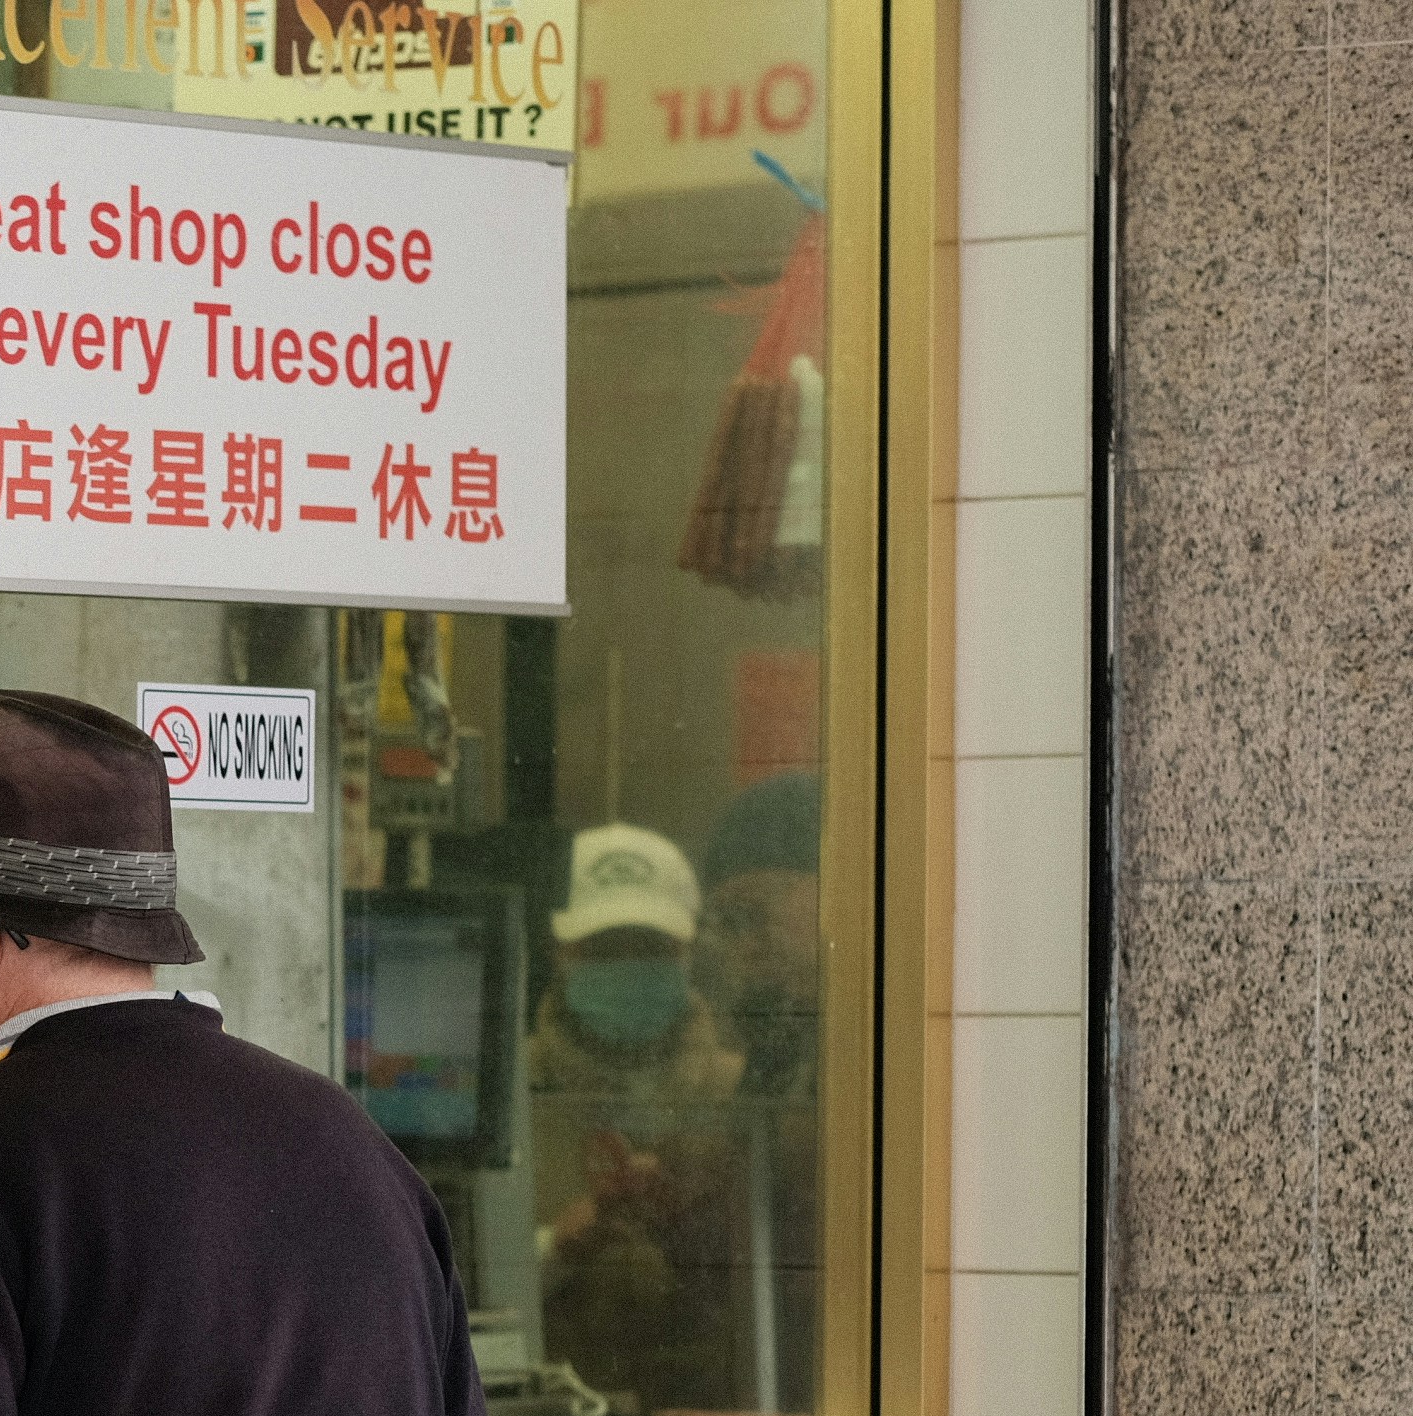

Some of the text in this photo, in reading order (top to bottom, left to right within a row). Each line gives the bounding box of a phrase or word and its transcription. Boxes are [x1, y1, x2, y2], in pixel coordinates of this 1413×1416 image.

[476, 107, 511, 138] IT
[90, 185, 248, 288] shop
[270, 201, 433, 284] close
[193, 302, 452, 413] Tuesday
[208, 711, 305, 782] NO SMOKING
